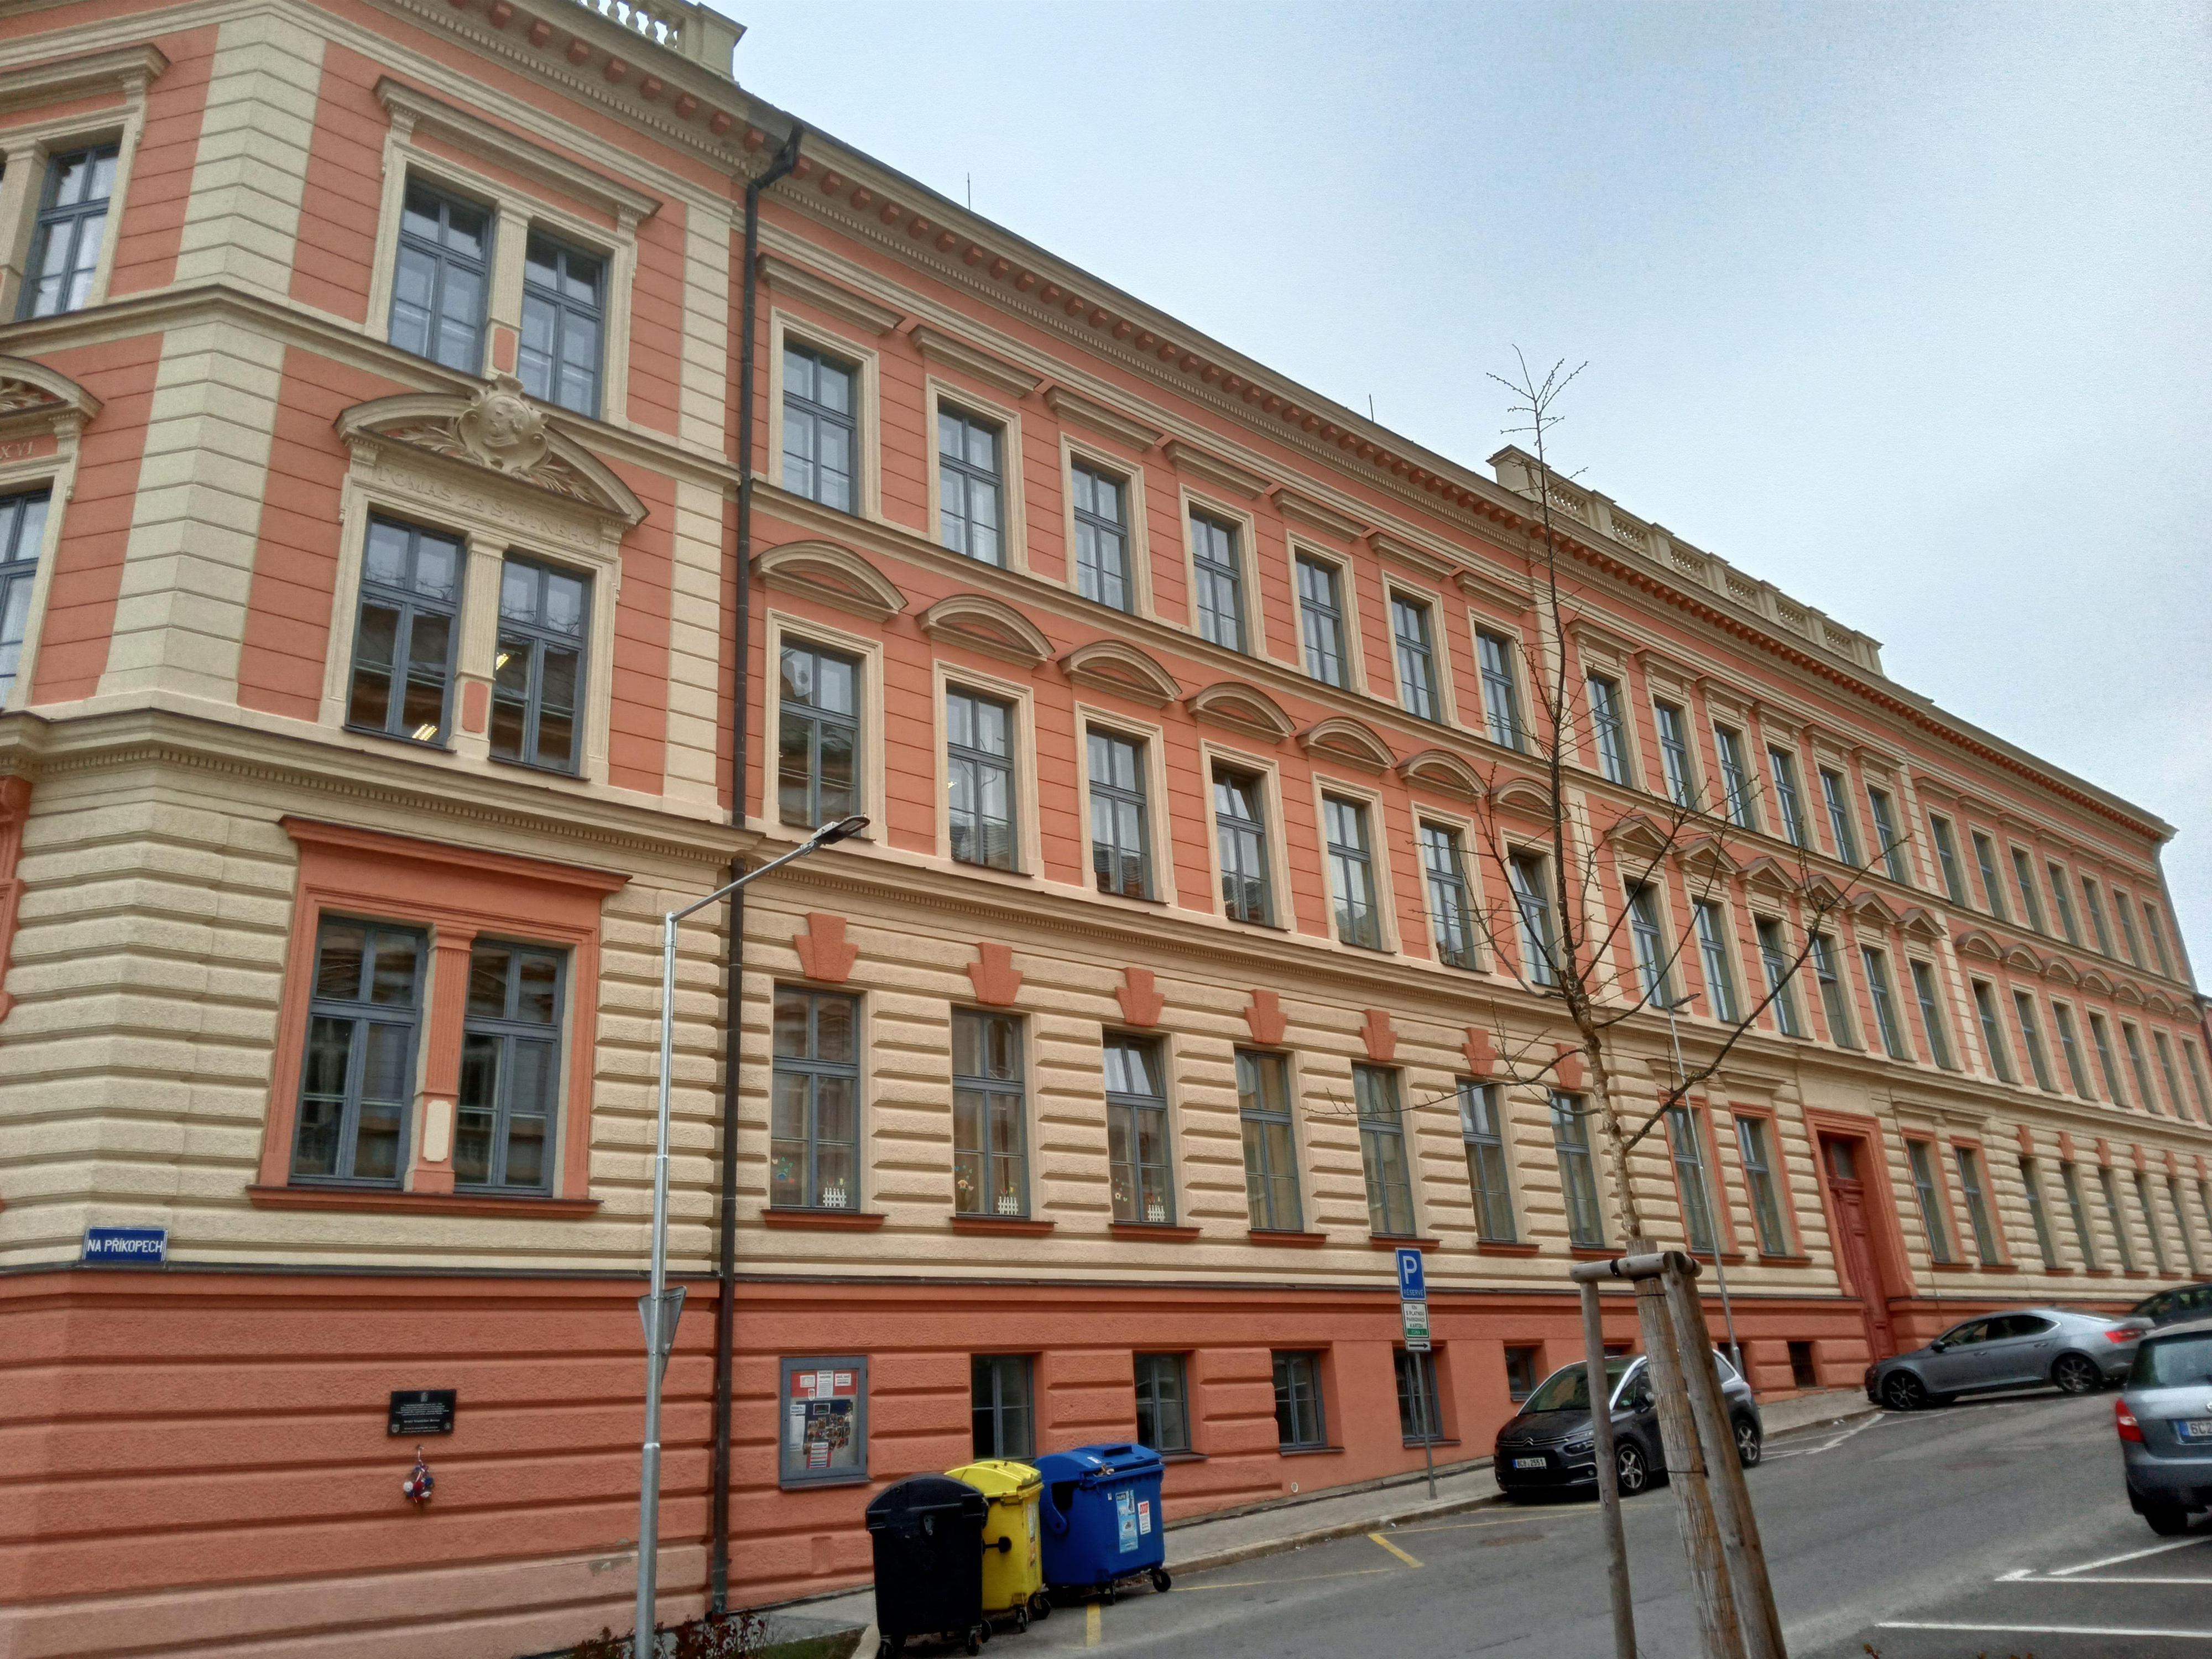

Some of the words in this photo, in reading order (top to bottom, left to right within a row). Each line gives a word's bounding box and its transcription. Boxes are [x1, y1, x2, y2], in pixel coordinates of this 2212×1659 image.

[459, 494, 484, 513] ZE
[87, 1239, 101, 1252] NA
[104, 1235, 164, 1253] PŘÍKOPECH
[1402, 1256, 1417, 1284] P
